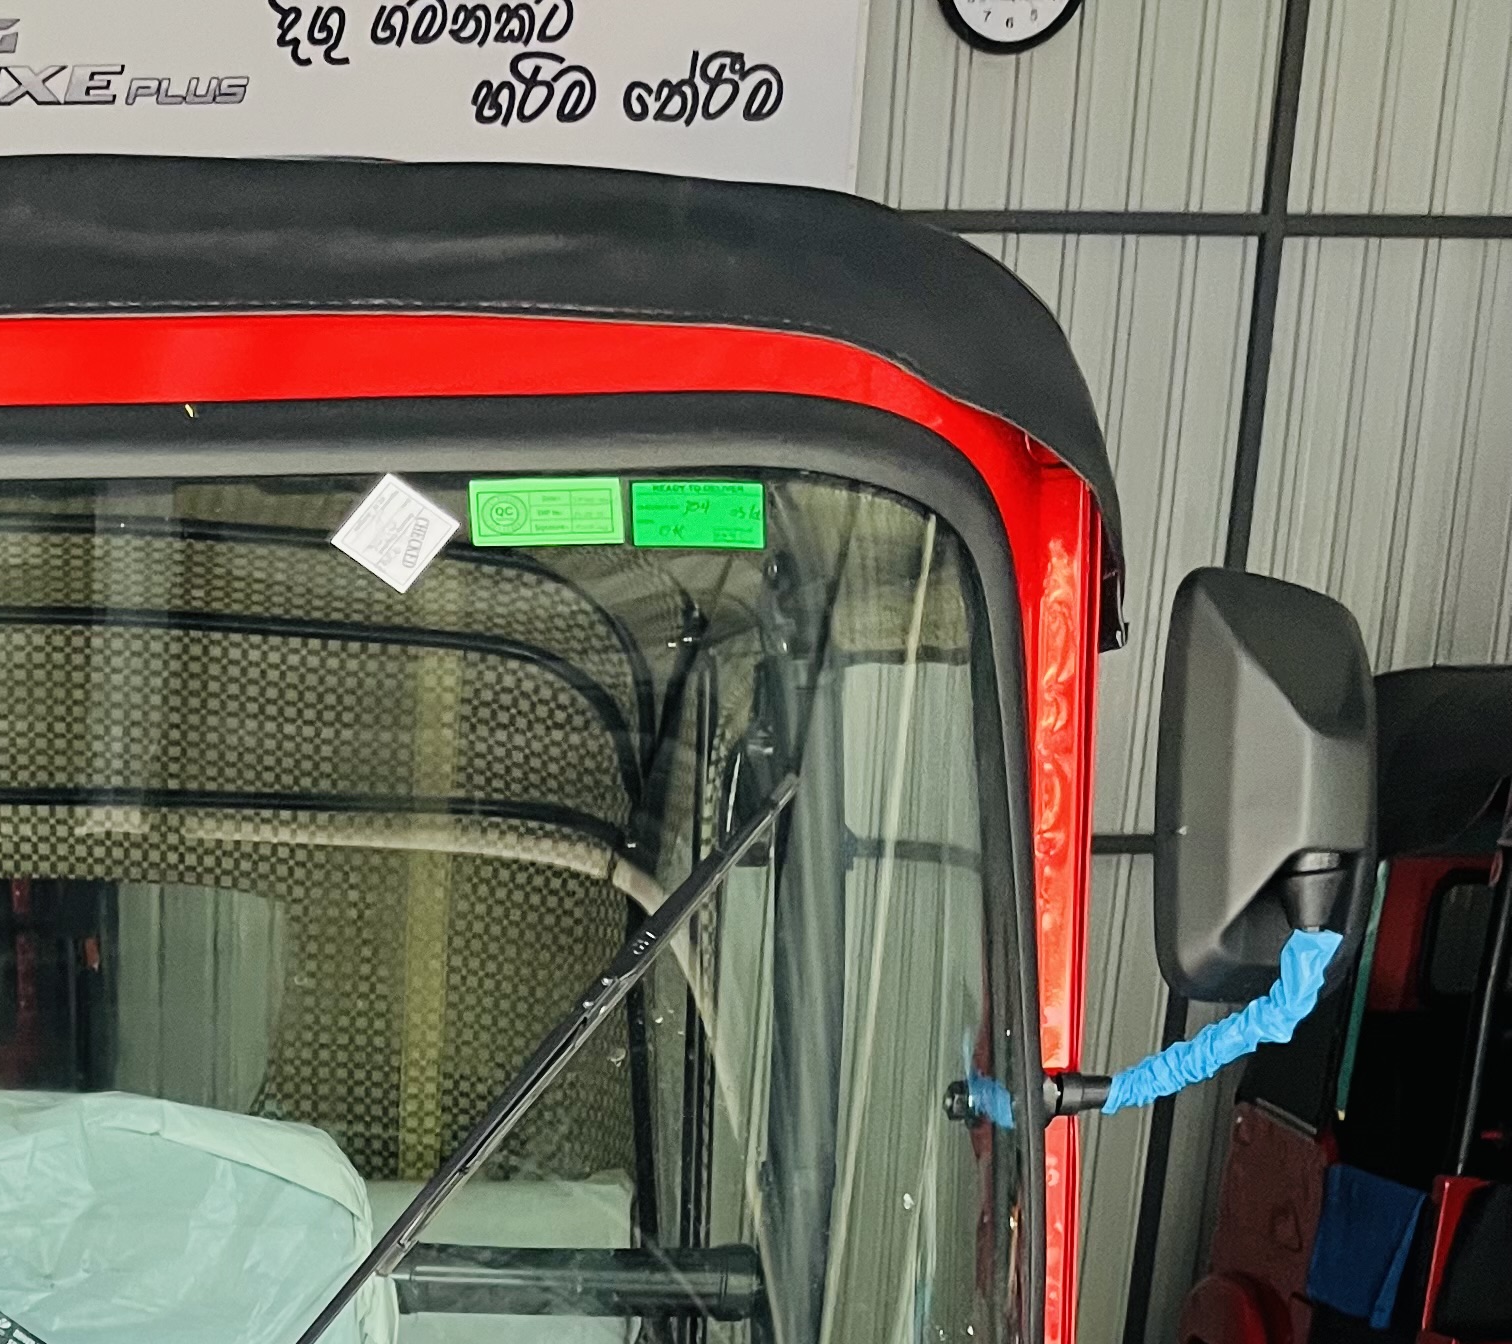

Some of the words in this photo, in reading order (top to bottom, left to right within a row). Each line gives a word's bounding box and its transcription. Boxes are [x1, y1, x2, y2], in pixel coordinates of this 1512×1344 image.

[1005, 16, 1014, 29] 6
[125, 76, 250, 106] PLUS
[495, 506, 514, 517] QC
